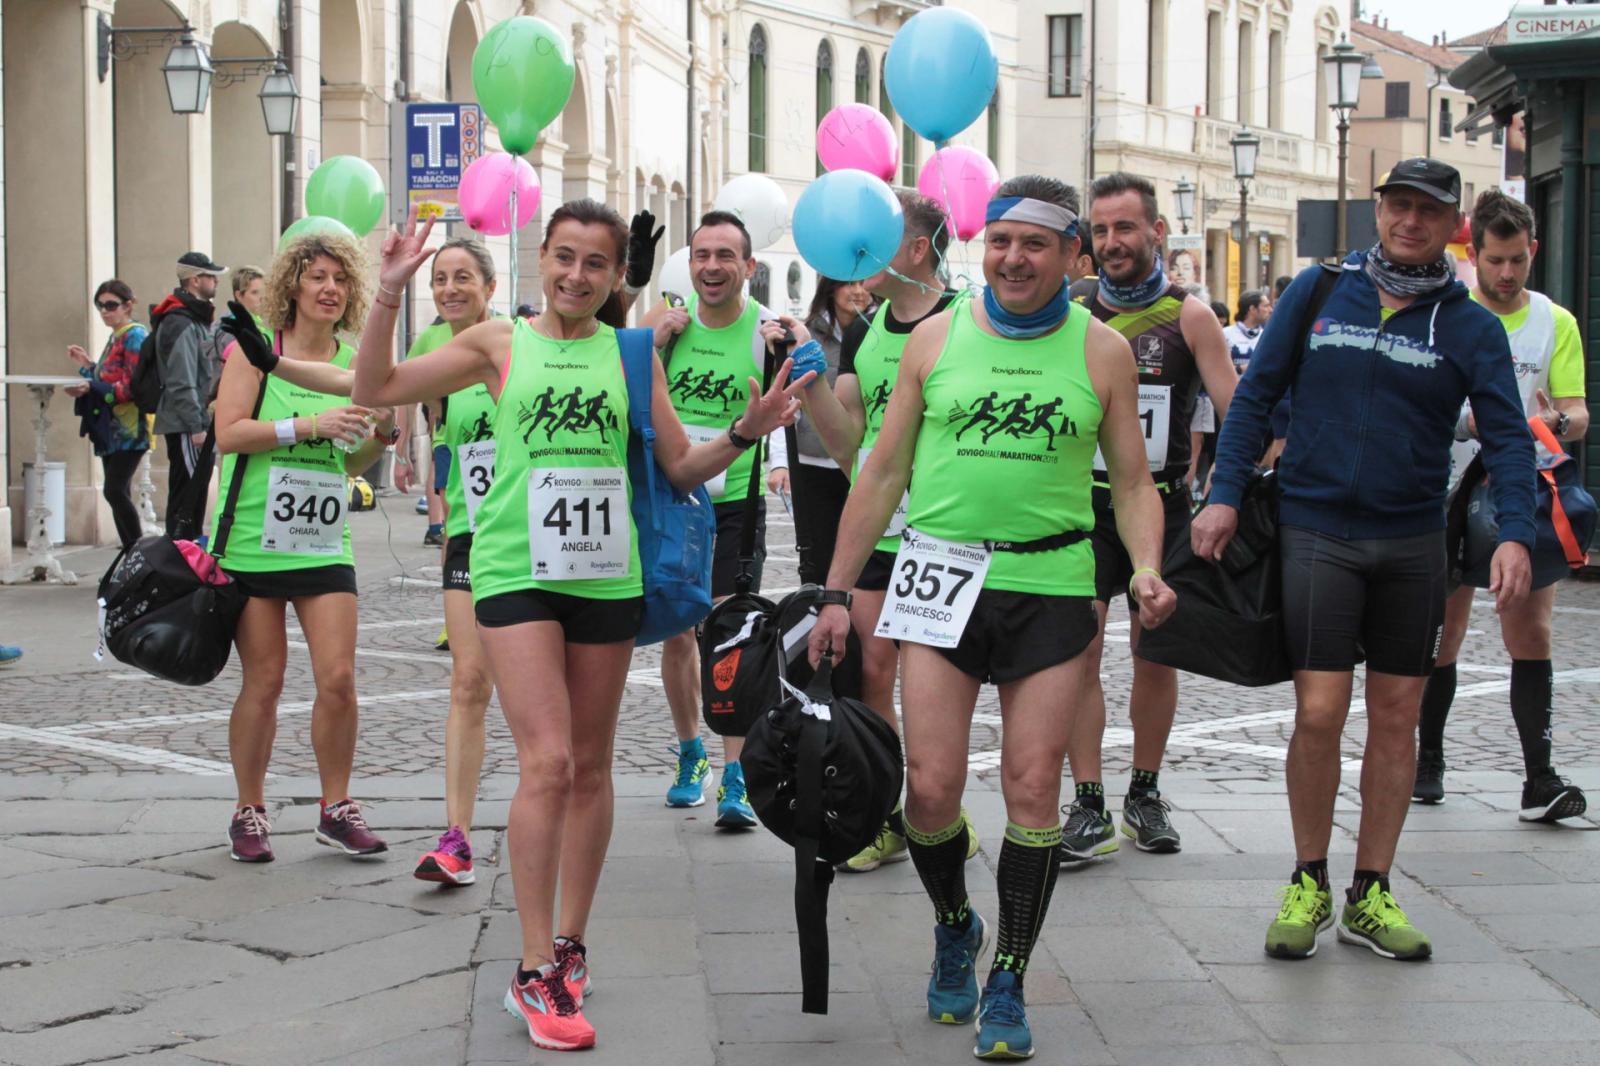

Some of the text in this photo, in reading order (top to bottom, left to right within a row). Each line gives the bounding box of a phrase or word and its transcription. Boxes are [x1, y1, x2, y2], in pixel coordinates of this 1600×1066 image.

[413, 113, 456, 168] T
[412, 175, 459, 184] TABACCHI
[544, 361, 589, 371] RovigoBanca
[991, 366, 1043, 377] RovigoBanca
[272, 491, 341, 526] 340
[543, 497, 611, 536] 411
[288, 525, 321, 537] CHIARA
[560, 541, 603, 552] ANGELA
[947, 545, 987, 563] MARATHON
[894, 558, 974, 608] 357
[894, 602, 953, 623] FRANCESCO
